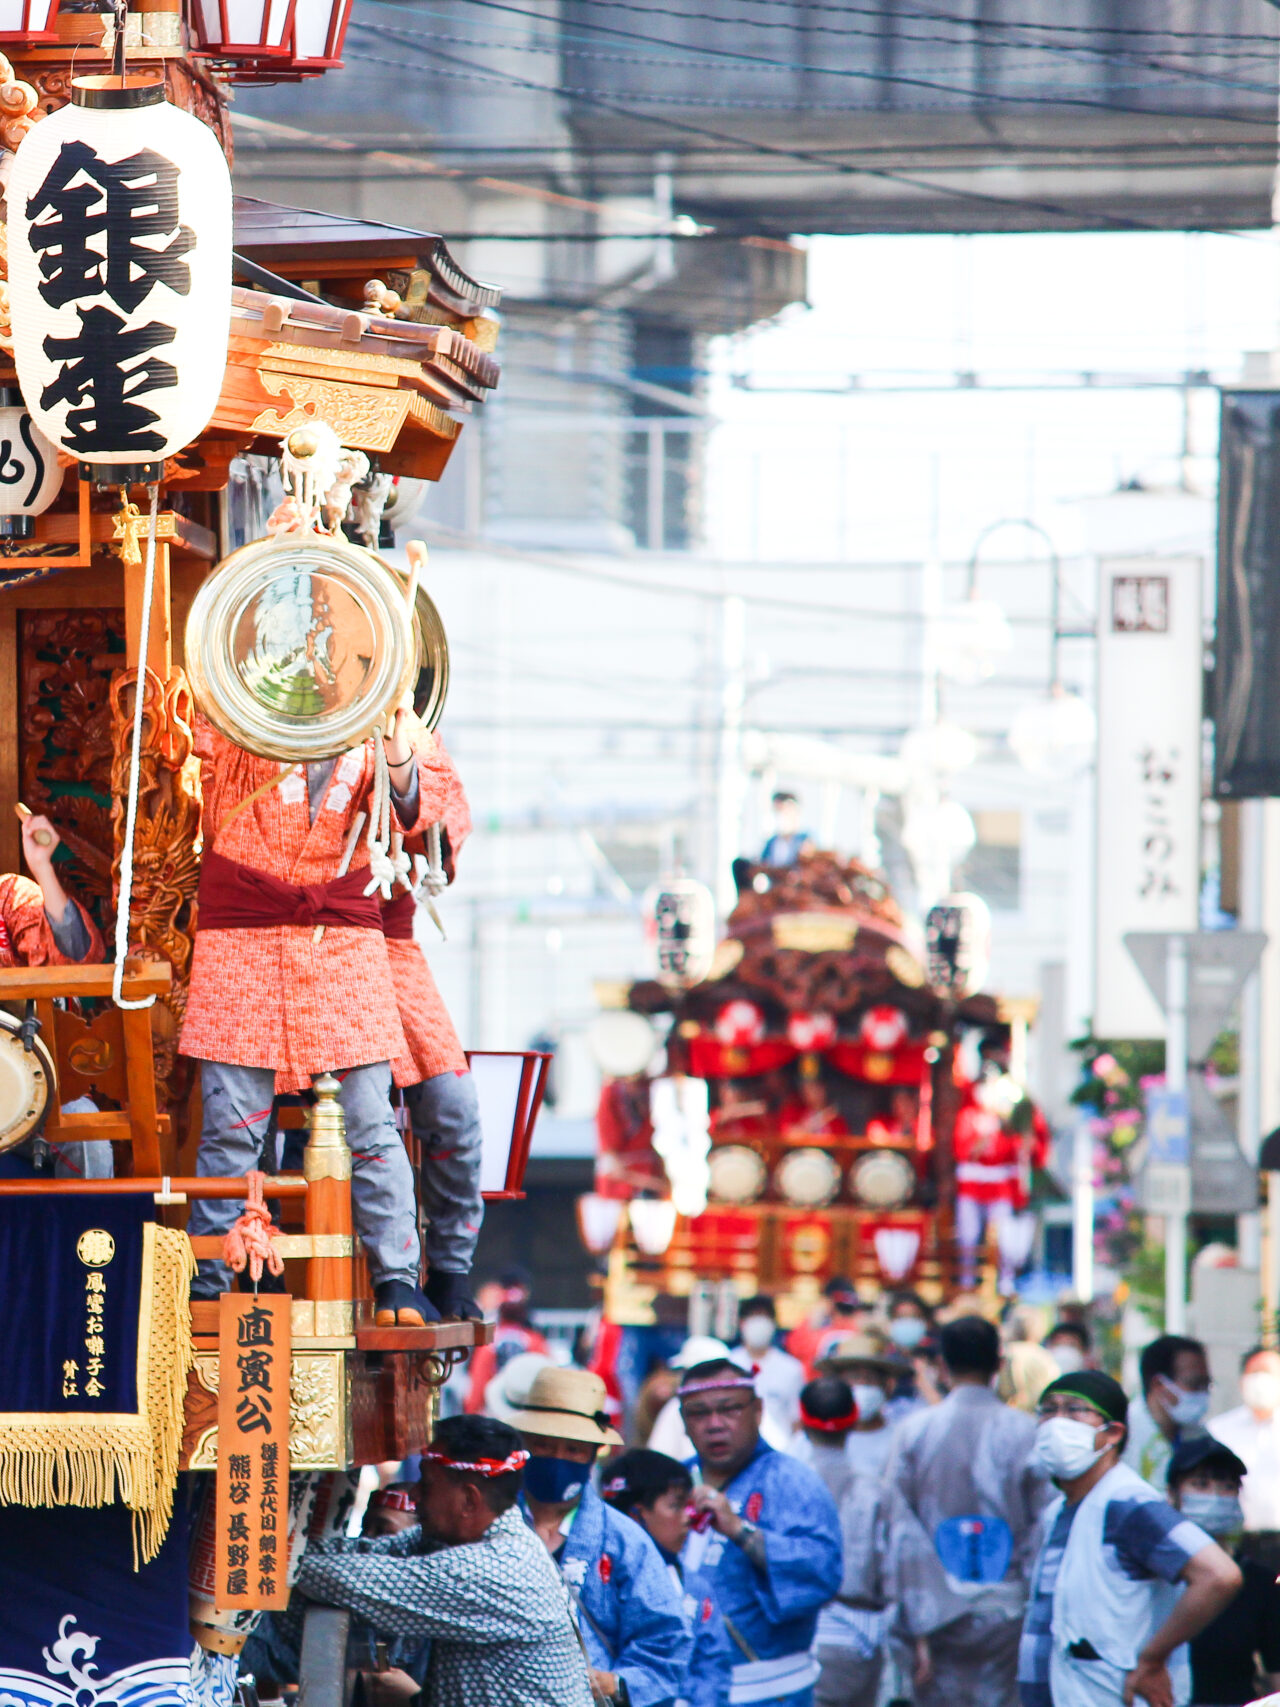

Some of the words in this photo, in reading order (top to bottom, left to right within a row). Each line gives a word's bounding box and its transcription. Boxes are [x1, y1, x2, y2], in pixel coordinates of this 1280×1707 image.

[25, 140, 198, 453] 銀座
[227, 1454, 252, 1504] 熊谷
[226, 1513, 251, 1596] 長野屋
